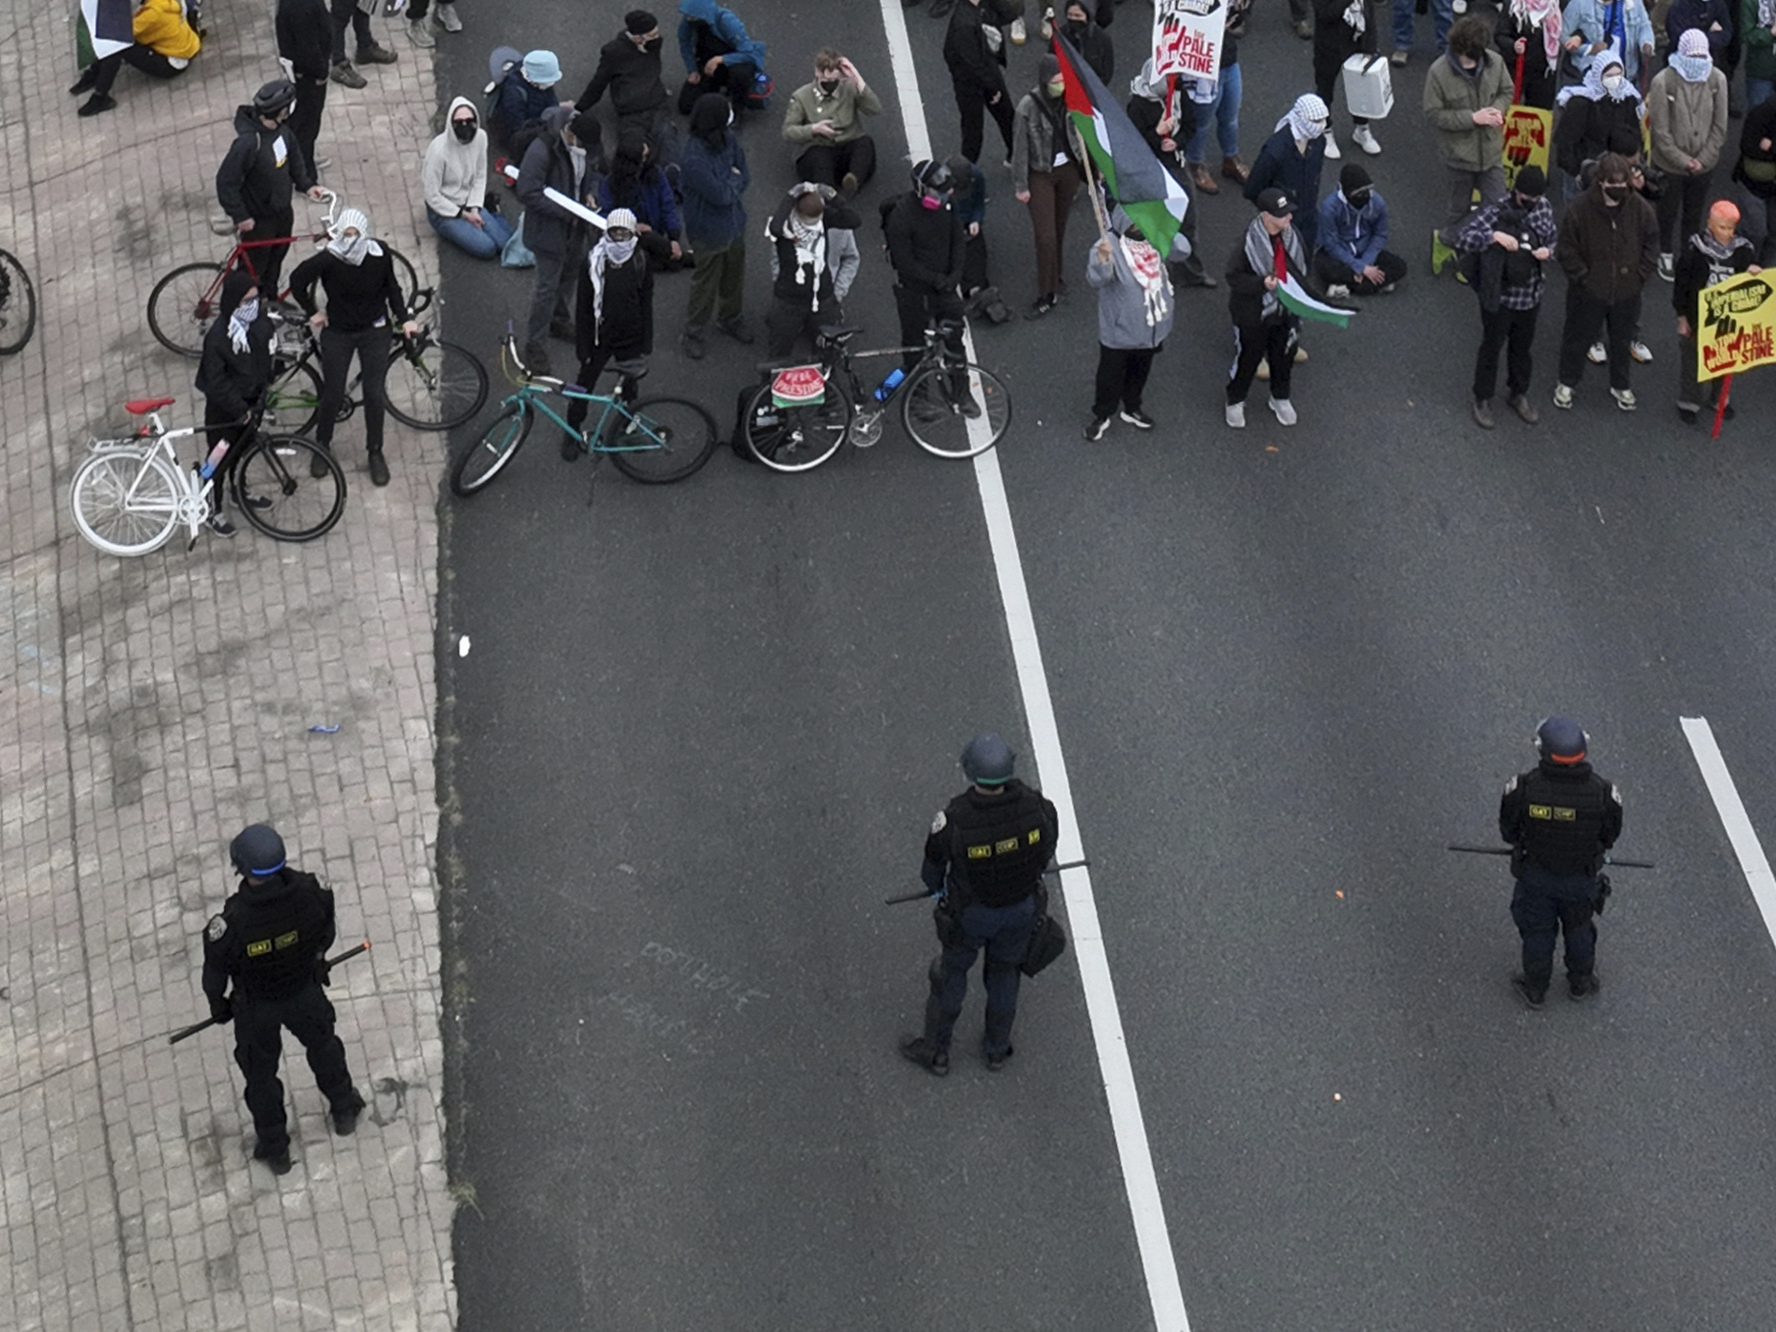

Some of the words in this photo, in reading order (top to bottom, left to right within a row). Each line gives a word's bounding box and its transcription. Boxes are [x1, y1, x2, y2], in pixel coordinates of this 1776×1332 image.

[1183, 34, 1216, 56] PALE
[1178, 53, 1214, 75] STINE
[1742, 326, 1773, 347] PALE
[1741, 344, 1774, 364] STINE
